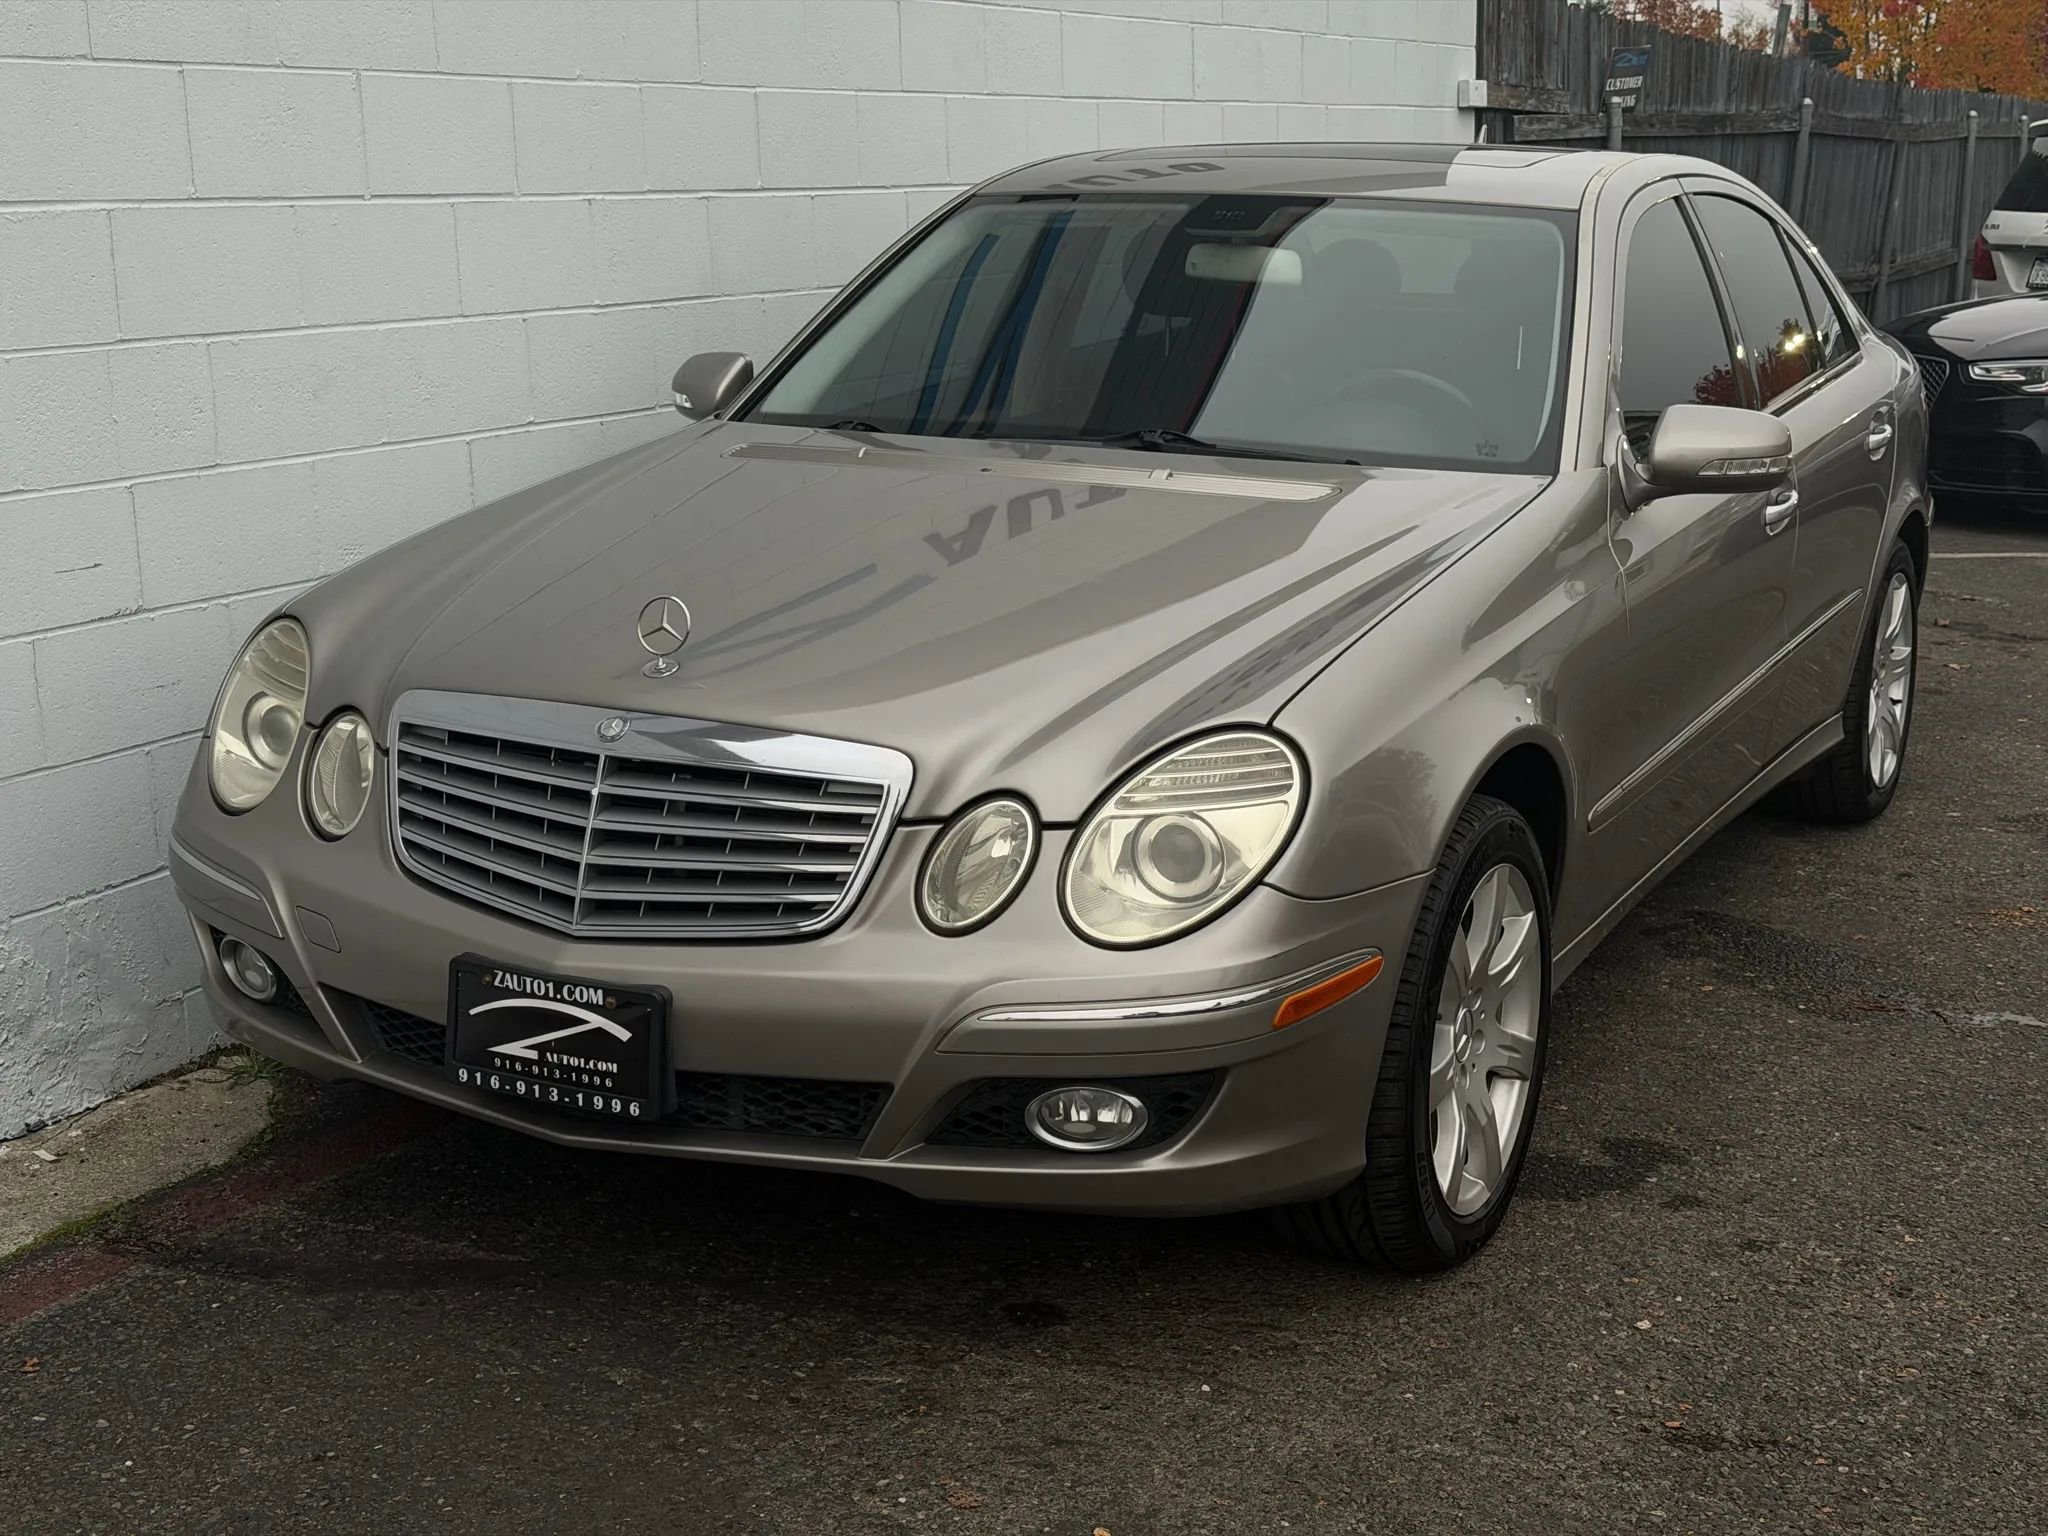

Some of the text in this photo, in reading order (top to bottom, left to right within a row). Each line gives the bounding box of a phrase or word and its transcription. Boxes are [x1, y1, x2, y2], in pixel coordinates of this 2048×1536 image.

[1605, 75, 1643, 91] CUSTOMER
[493, 969, 604, 1006] ZAUTO1.COM
[493, 1057, 614, 1088] 916-913-1996
[543, 1051, 619, 1074] AUTO1.COM
[457, 1067, 641, 1117] 916-913-1996
